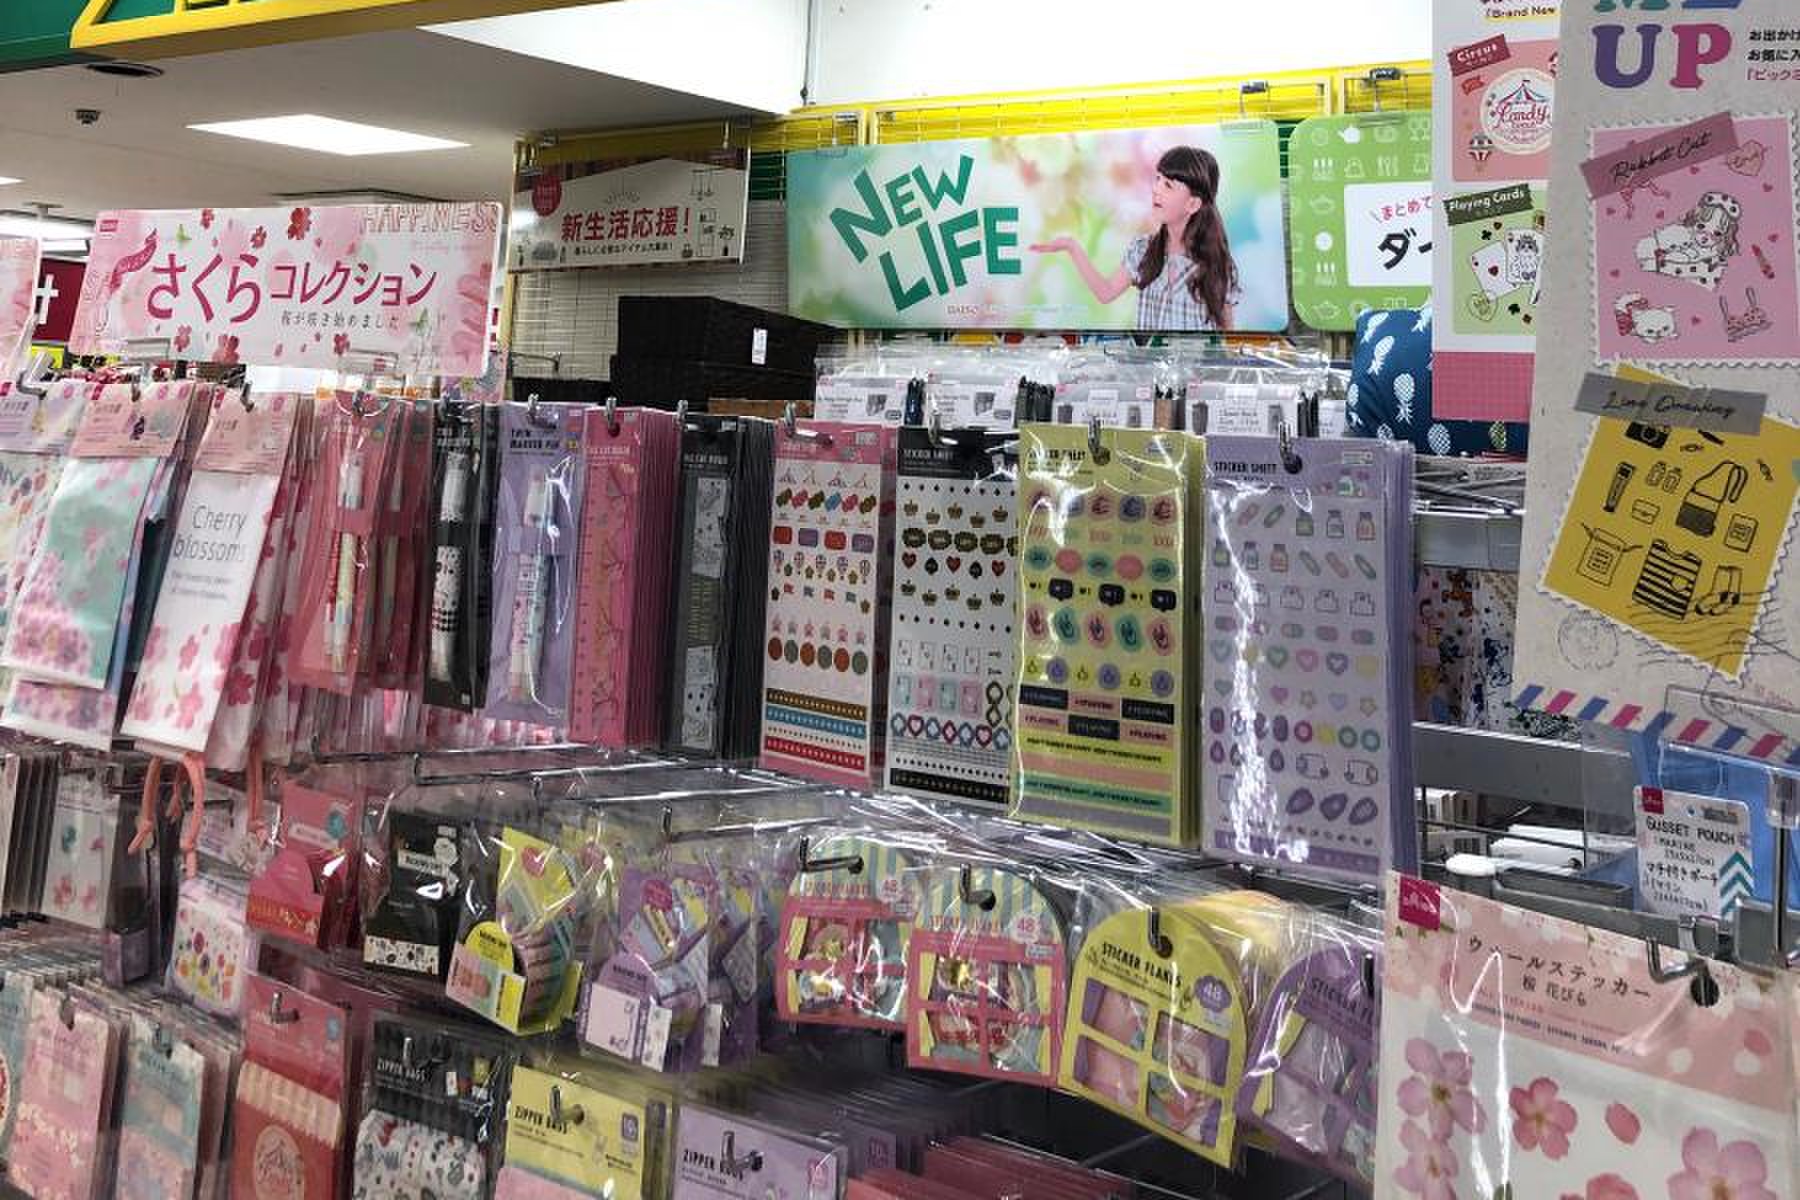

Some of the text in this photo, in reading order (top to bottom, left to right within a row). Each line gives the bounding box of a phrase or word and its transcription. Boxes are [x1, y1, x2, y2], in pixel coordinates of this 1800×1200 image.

[1591, 22, 1734, 90] UP
[829, 155, 974, 263] NEW
[1492, 187, 1525, 204] Cards
[560, 205, 691, 243] 新生活応援!
[877, 206, 1022, 312] LIFE
[192, 504, 248, 540] Cherry
[1696, 827, 1736, 846] POUCH
[1016, 918, 1034, 932] 48
[1102, 941, 1141, 969] STICKER
[514, 1104, 544, 1125] ZIPPER
[683, 1149, 715, 1170] ZIPPER
